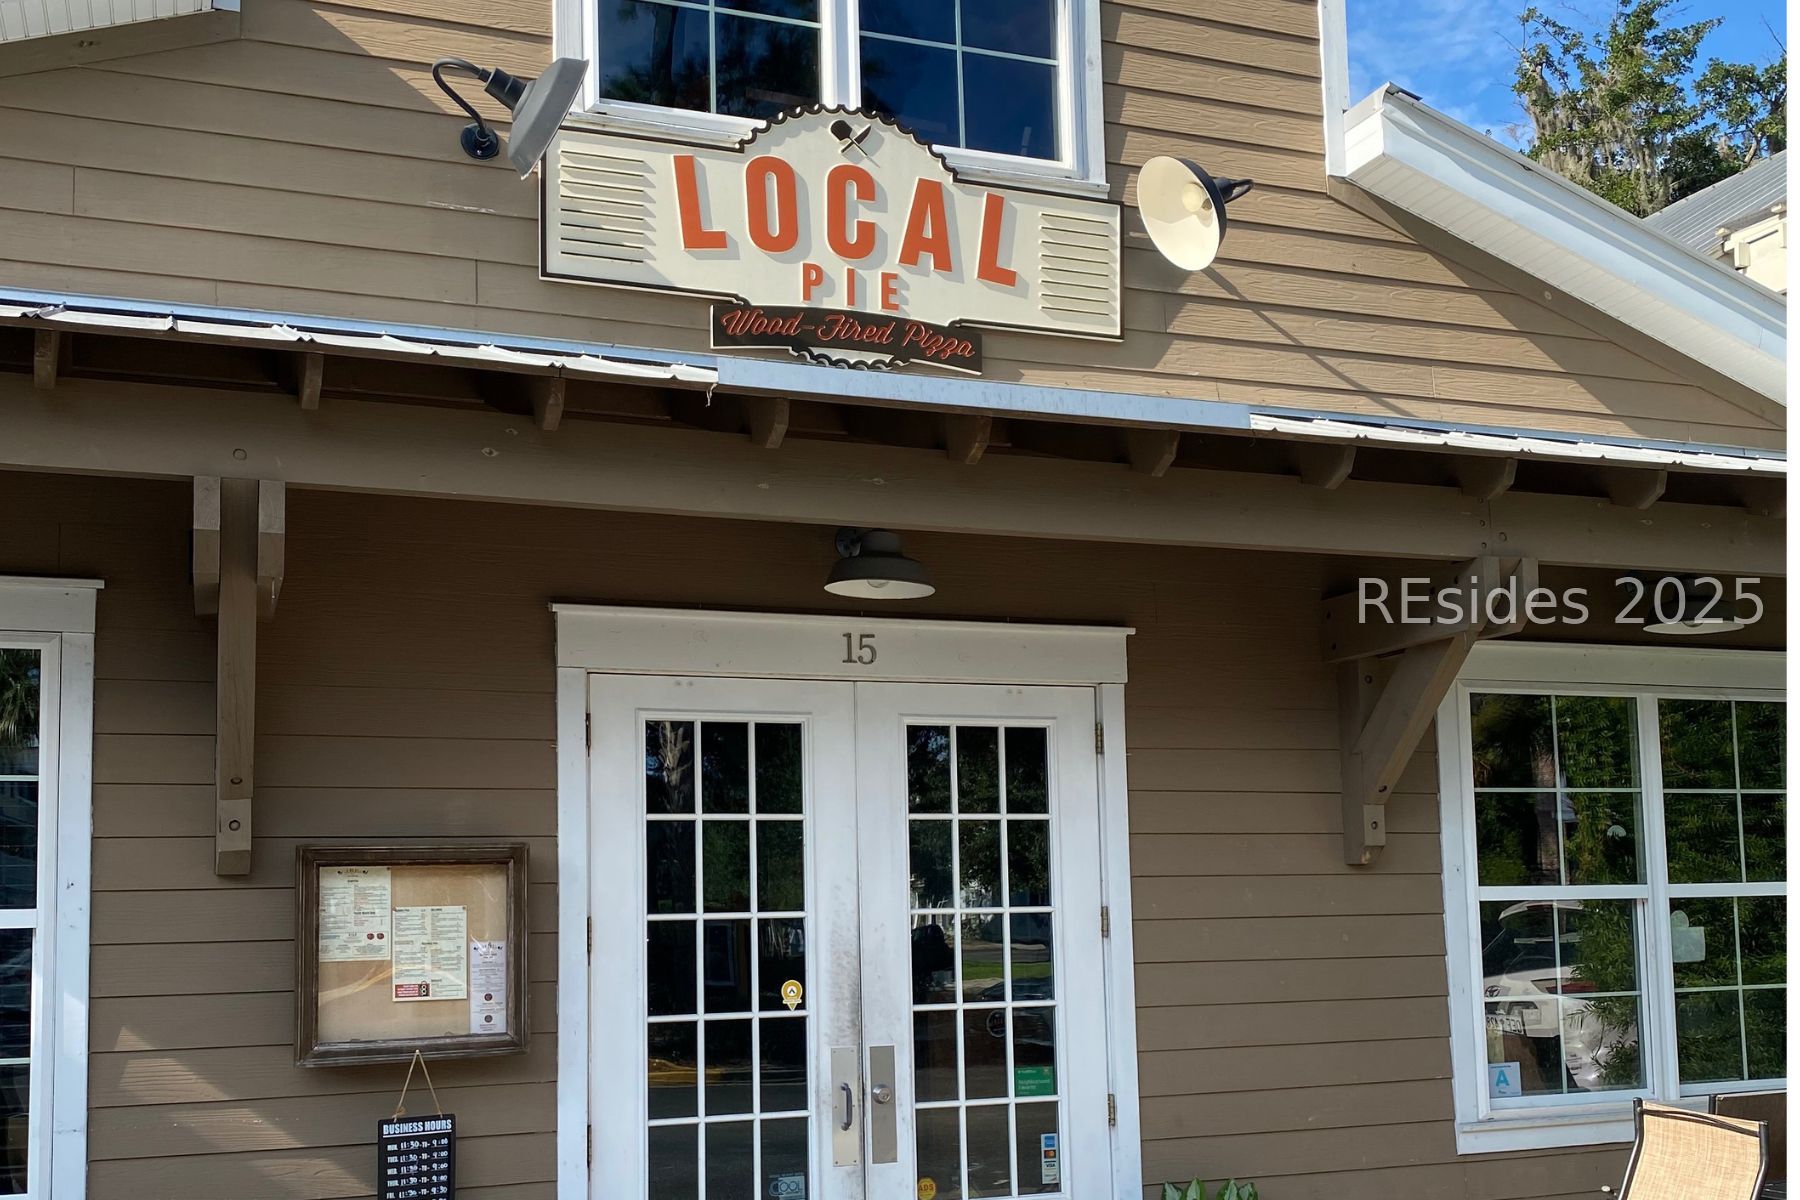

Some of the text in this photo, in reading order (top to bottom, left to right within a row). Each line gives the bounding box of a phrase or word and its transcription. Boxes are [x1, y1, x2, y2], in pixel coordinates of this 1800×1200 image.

[673, 154, 1017, 287] LOCAL
[802, 262, 900, 311] PIE
[720, 308, 975, 360] Wood-Fired Pizza
[842, 632, 877, 665] 15
[1495, 1069, 1510, 1087] A
[383, 1119, 452, 1135] BUSINESS HOURS
